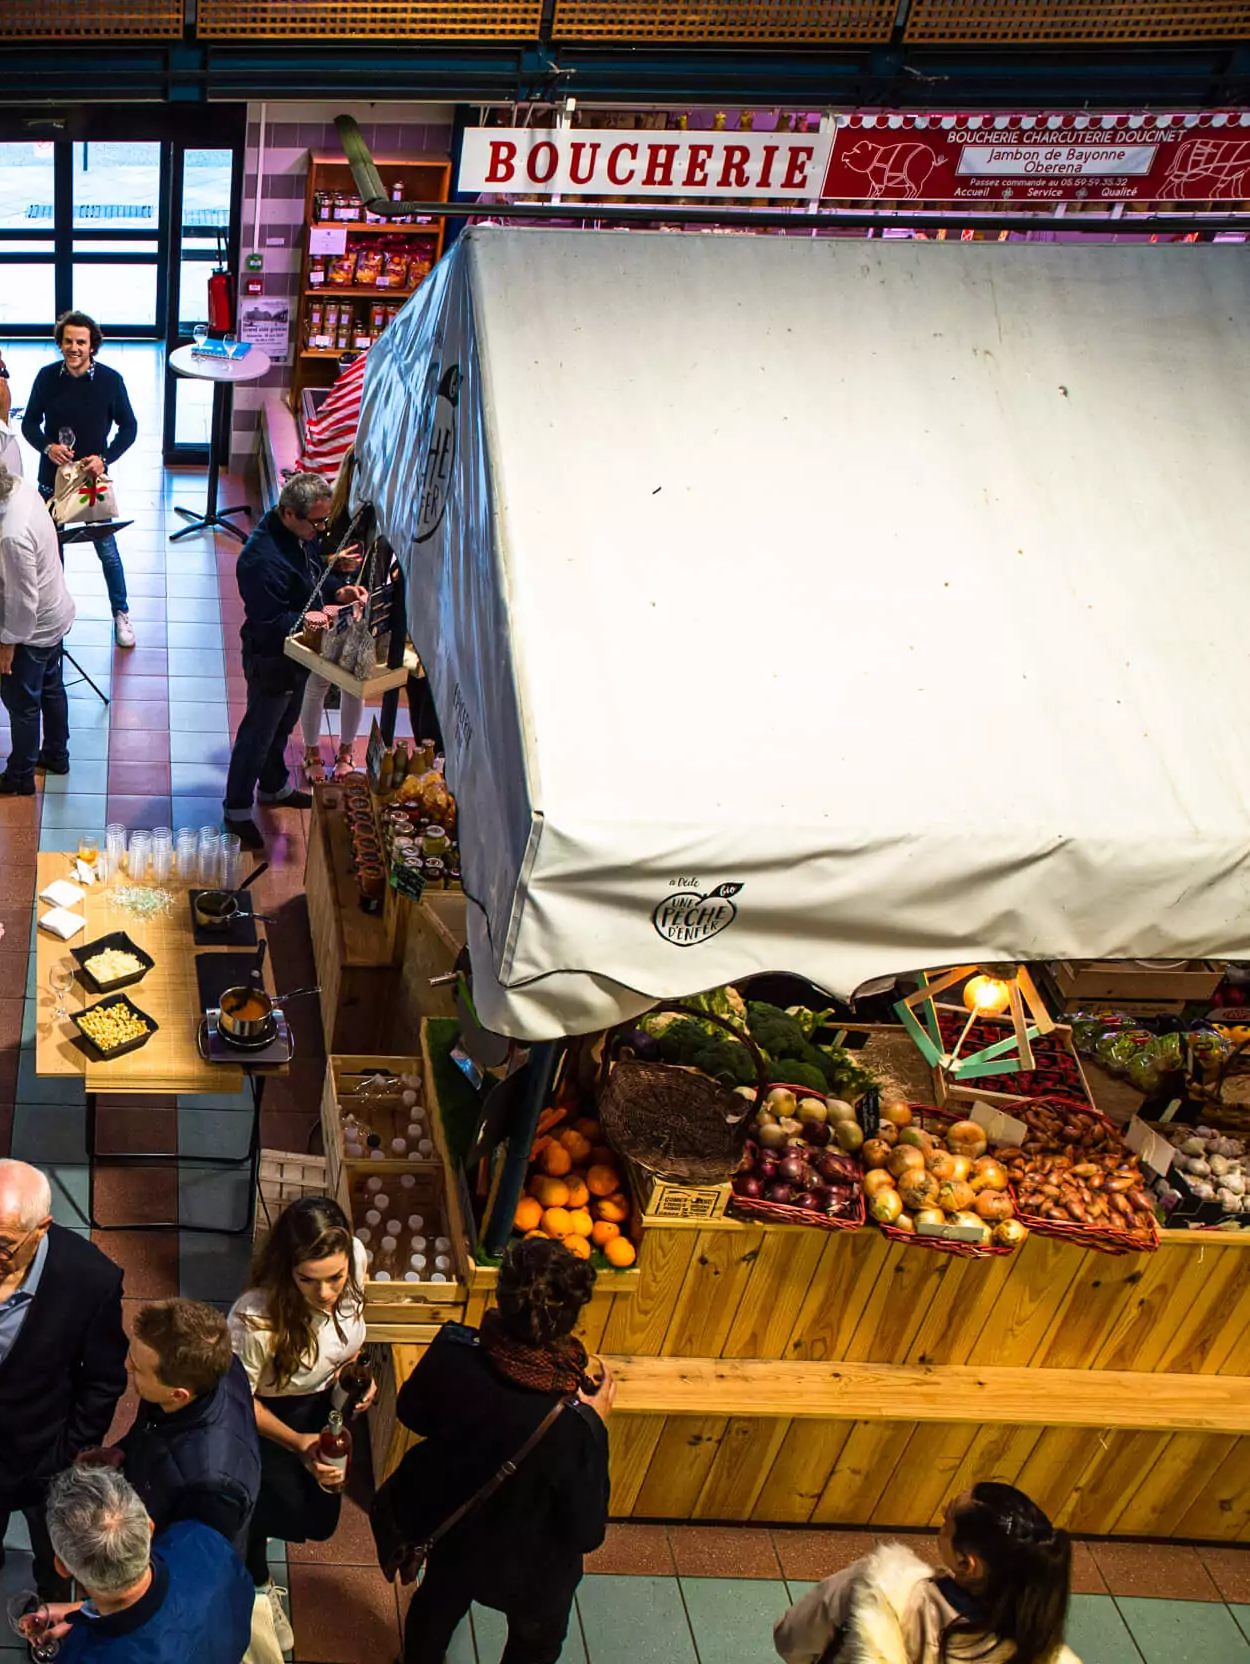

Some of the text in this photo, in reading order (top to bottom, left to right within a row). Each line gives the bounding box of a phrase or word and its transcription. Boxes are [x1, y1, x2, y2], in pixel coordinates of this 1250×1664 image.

[947, 130, 1188, 143] BOUCHERIE CHARCUTERIE DOUCINET
[986, 148, 1126, 164] Jambon de Bayonne
[484, 140, 815, 189] BOUCHERIE
[1024, 161, 1083, 173] Oberena
[970, 178, 1000, 187] Passez
[1002, 178, 1046, 187] commande
[954, 187, 990, 197] Accueil
[1027, 187, 1064, 197] Service
[1101, 187, 1138, 197] Qualité
[672, 898, 695, 909] UNE
[668, 920, 718, 941] D'ENFER
